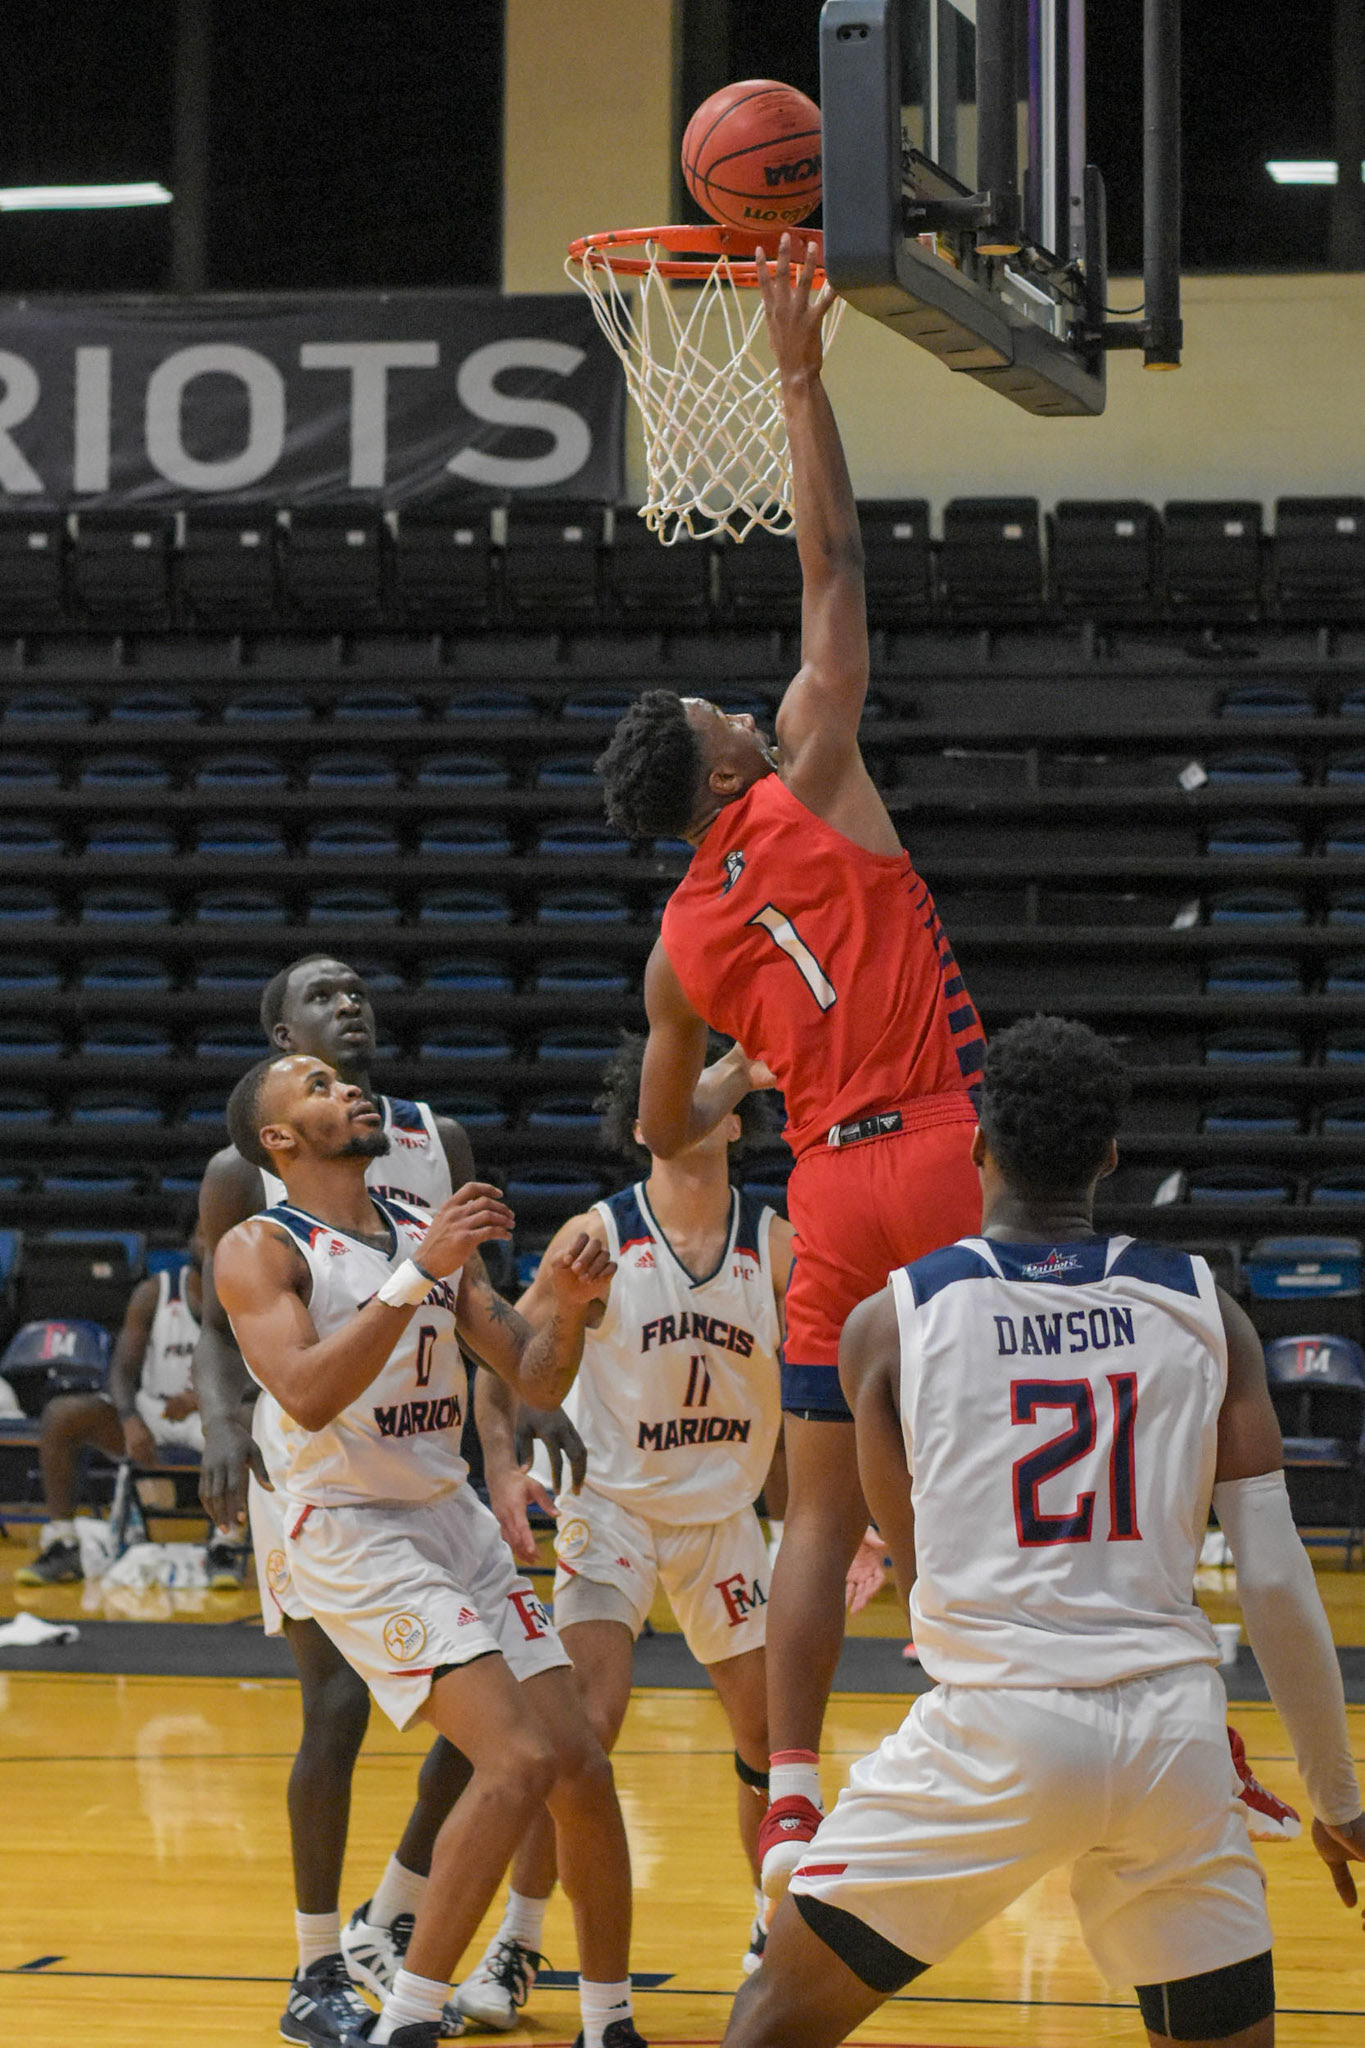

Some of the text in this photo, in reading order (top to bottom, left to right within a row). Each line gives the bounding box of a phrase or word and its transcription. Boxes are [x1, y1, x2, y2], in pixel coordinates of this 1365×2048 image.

[745, 902, 837, 1014] 1
[641, 1311, 755, 1358] FRANCIS
[994, 1307, 1136, 1356] DAWSON
[682, 1354, 711, 1407] 11
[373, 1395, 462, 1438] MARION
[637, 1416, 752, 1452] MARION
[1010, 1372, 1143, 1548] 21
